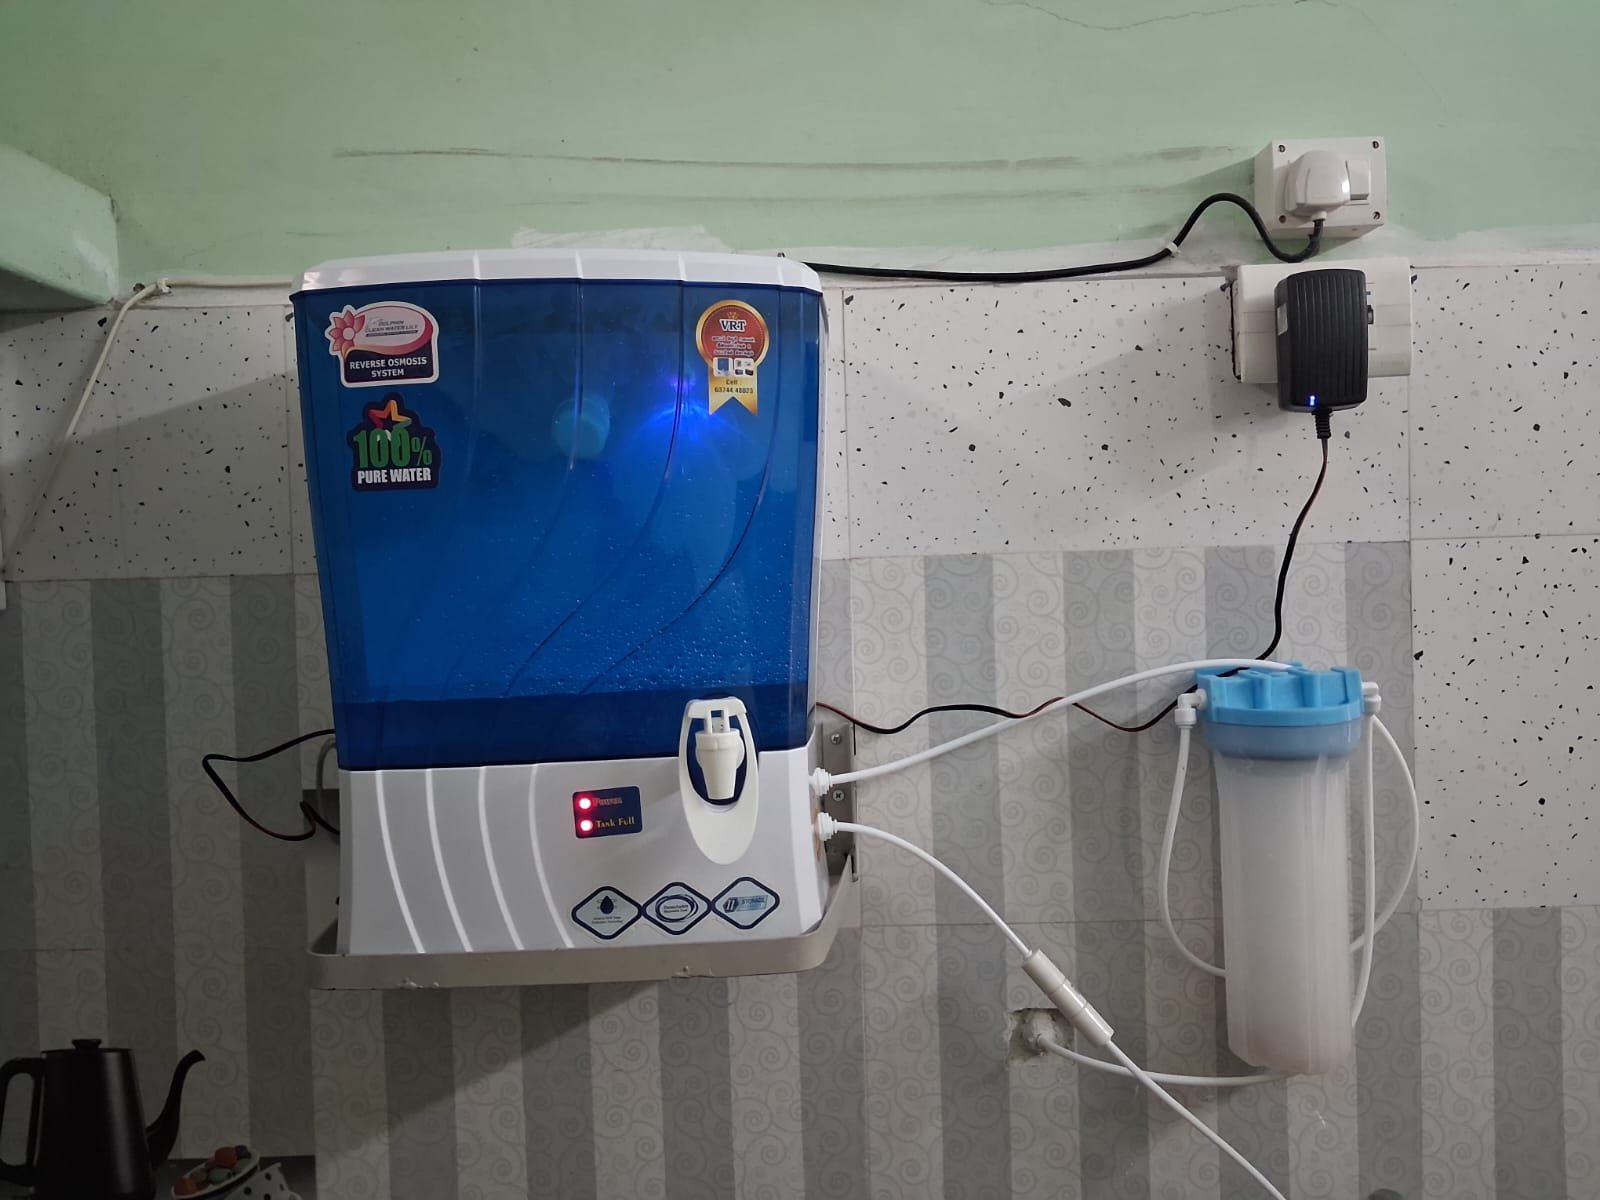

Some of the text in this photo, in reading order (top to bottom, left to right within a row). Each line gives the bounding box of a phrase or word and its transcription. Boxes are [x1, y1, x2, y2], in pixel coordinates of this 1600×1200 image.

[350, 357, 427, 369] REVERSE OSMOSIS
[371, 368, 404, 378] SYSTEM
[353, 428, 432, 468] 100%
[357, 467, 431, 484] PURE WATER
